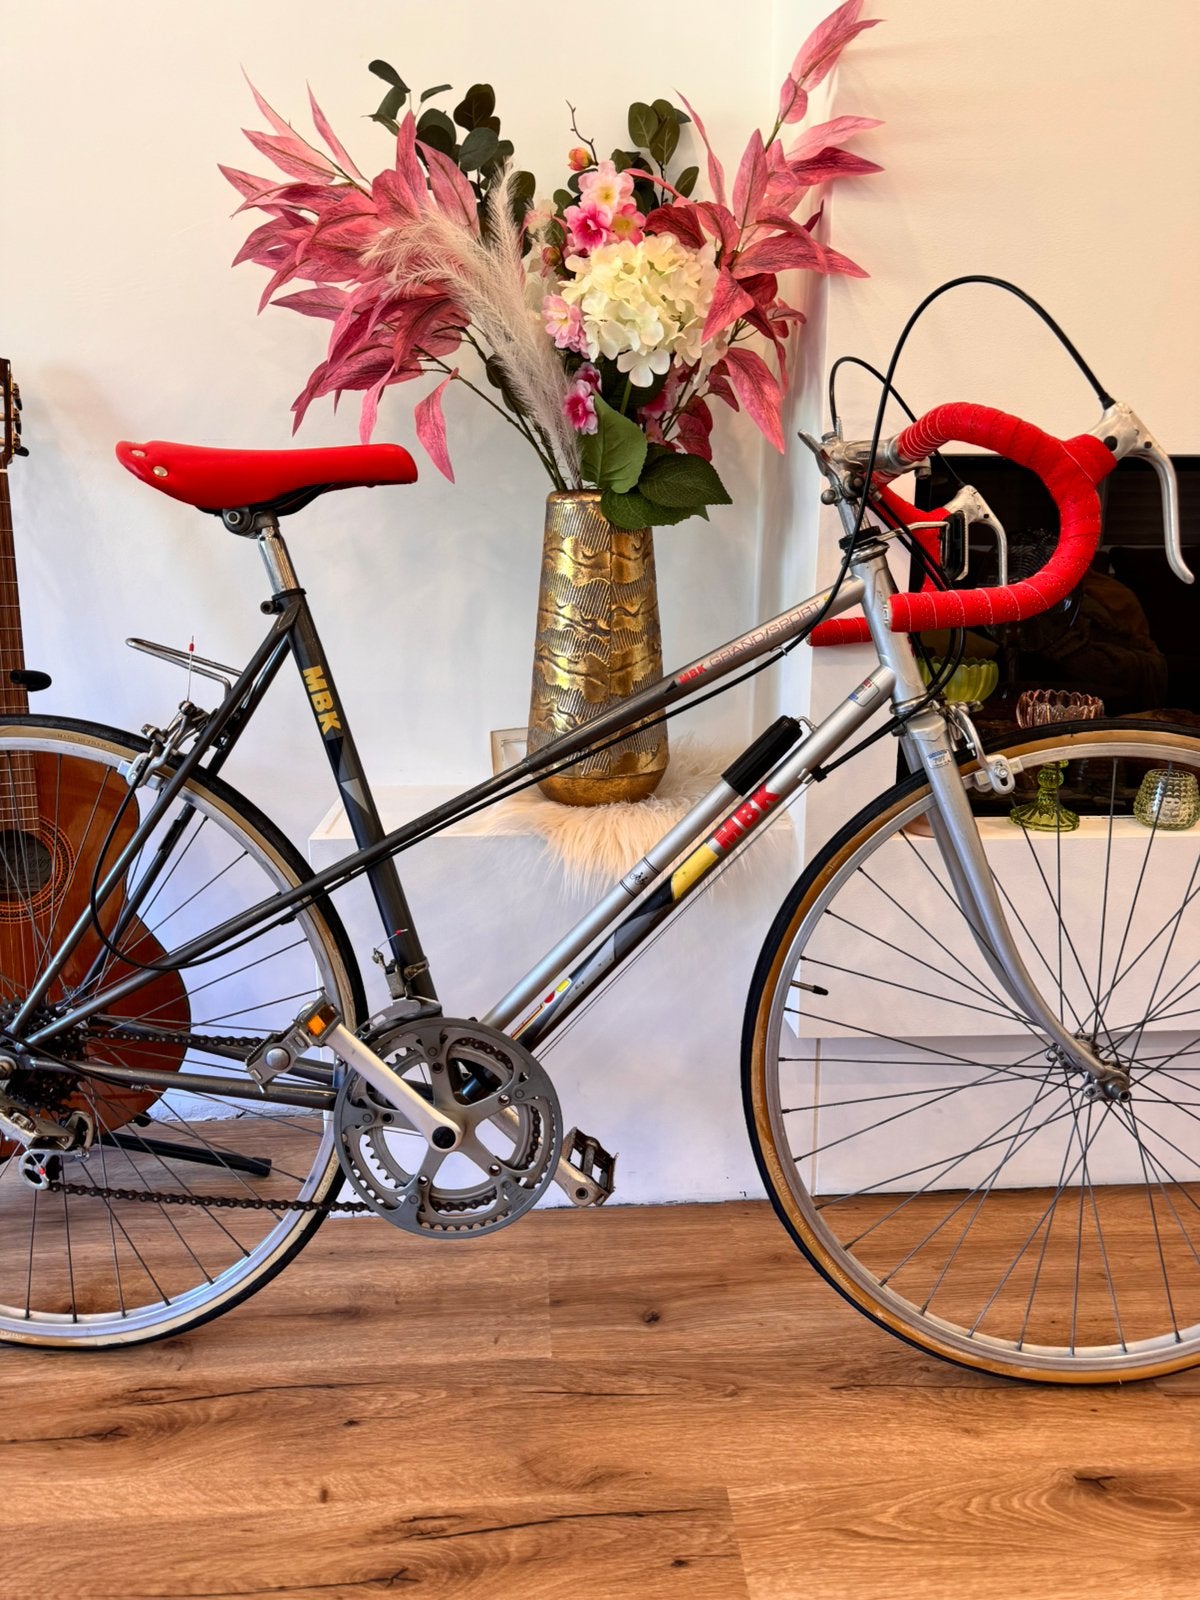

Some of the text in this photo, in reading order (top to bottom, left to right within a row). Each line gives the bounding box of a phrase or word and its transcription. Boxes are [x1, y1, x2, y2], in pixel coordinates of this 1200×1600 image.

[302, 665, 341, 735] MBK
[678, 663, 708, 685] MBK
[713, 783, 781, 849] MBK
